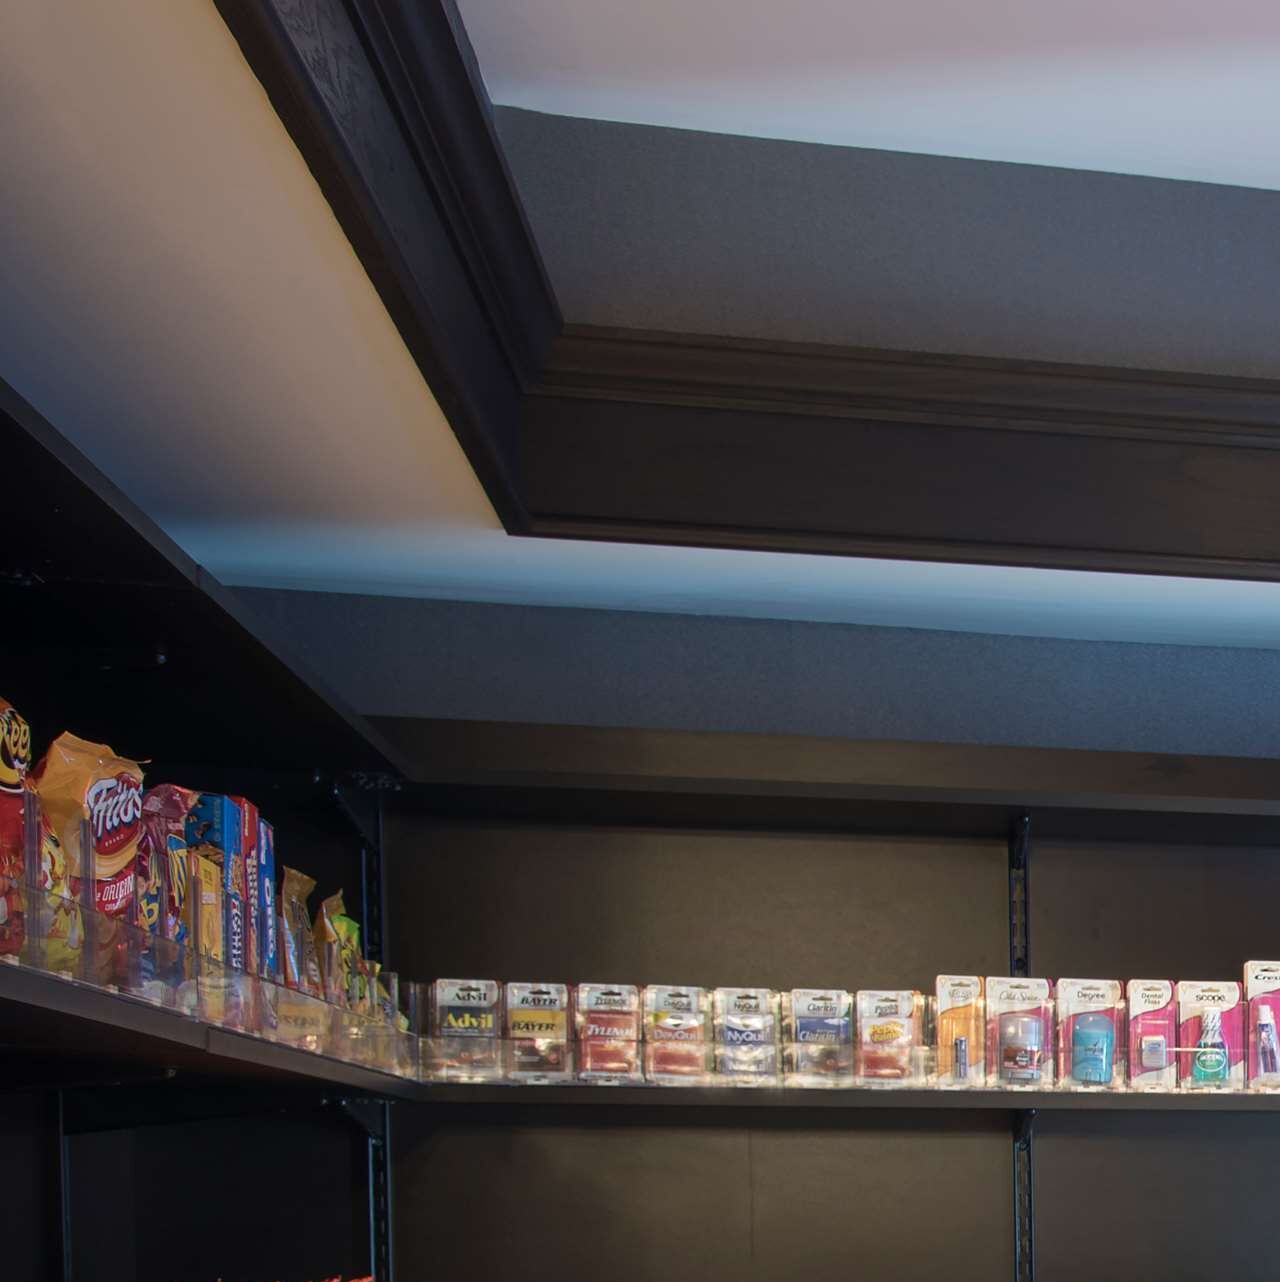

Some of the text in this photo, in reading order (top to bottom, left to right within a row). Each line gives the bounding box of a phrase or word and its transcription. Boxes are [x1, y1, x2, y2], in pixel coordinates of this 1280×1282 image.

[87, 776, 143, 840] Fritos
[1077, 991, 1106, 1001] Degree
[1196, 994, 1226, 1004] scope
[521, 997, 558, 1006] BAYER
[734, 1001, 760, 1011] NyQuil
[808, 1003, 837, 1012] Claritin
[444, 1012, 494, 1029] Advil
[512, 1022, 556, 1032] BAYER
[727, 1031, 765, 1044] NyQuil
